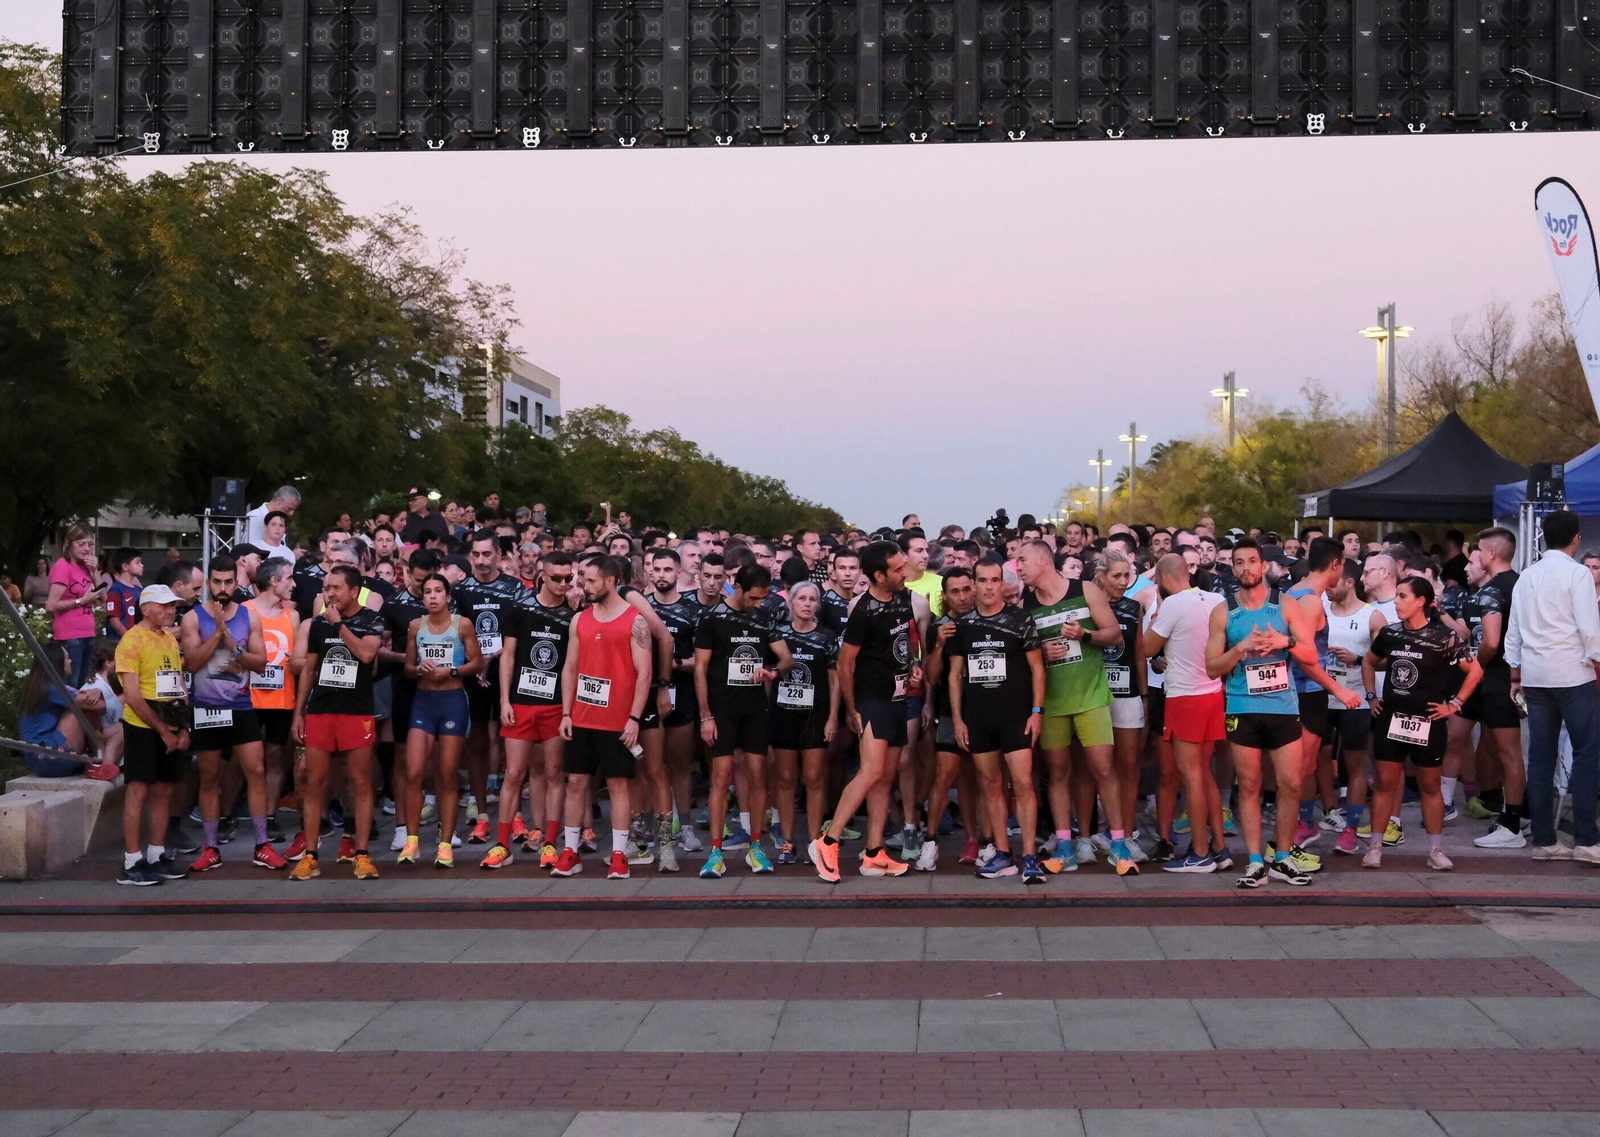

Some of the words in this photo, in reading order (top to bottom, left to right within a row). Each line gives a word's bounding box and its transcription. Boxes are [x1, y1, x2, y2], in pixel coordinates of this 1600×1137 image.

[473, 603, 500, 611] RUNMONES
[531, 630, 561, 641] RUNMONES
[424, 648, 446, 658] 1083
[1390, 650, 1423, 660] RUNMONES
[332, 665, 346, 676] 176
[740, 664, 755, 674] 691
[977, 660, 995, 670] 253
[173, 676, 177, 685] 1
[528, 674, 548, 687] 1316
[1106, 671, 1121, 682] 767
[1258, 669, 1277, 681] 944
[583, 682, 602, 694] 1062
[787, 688, 804, 699] 228
[1400, 719, 1422, 732] 1037
